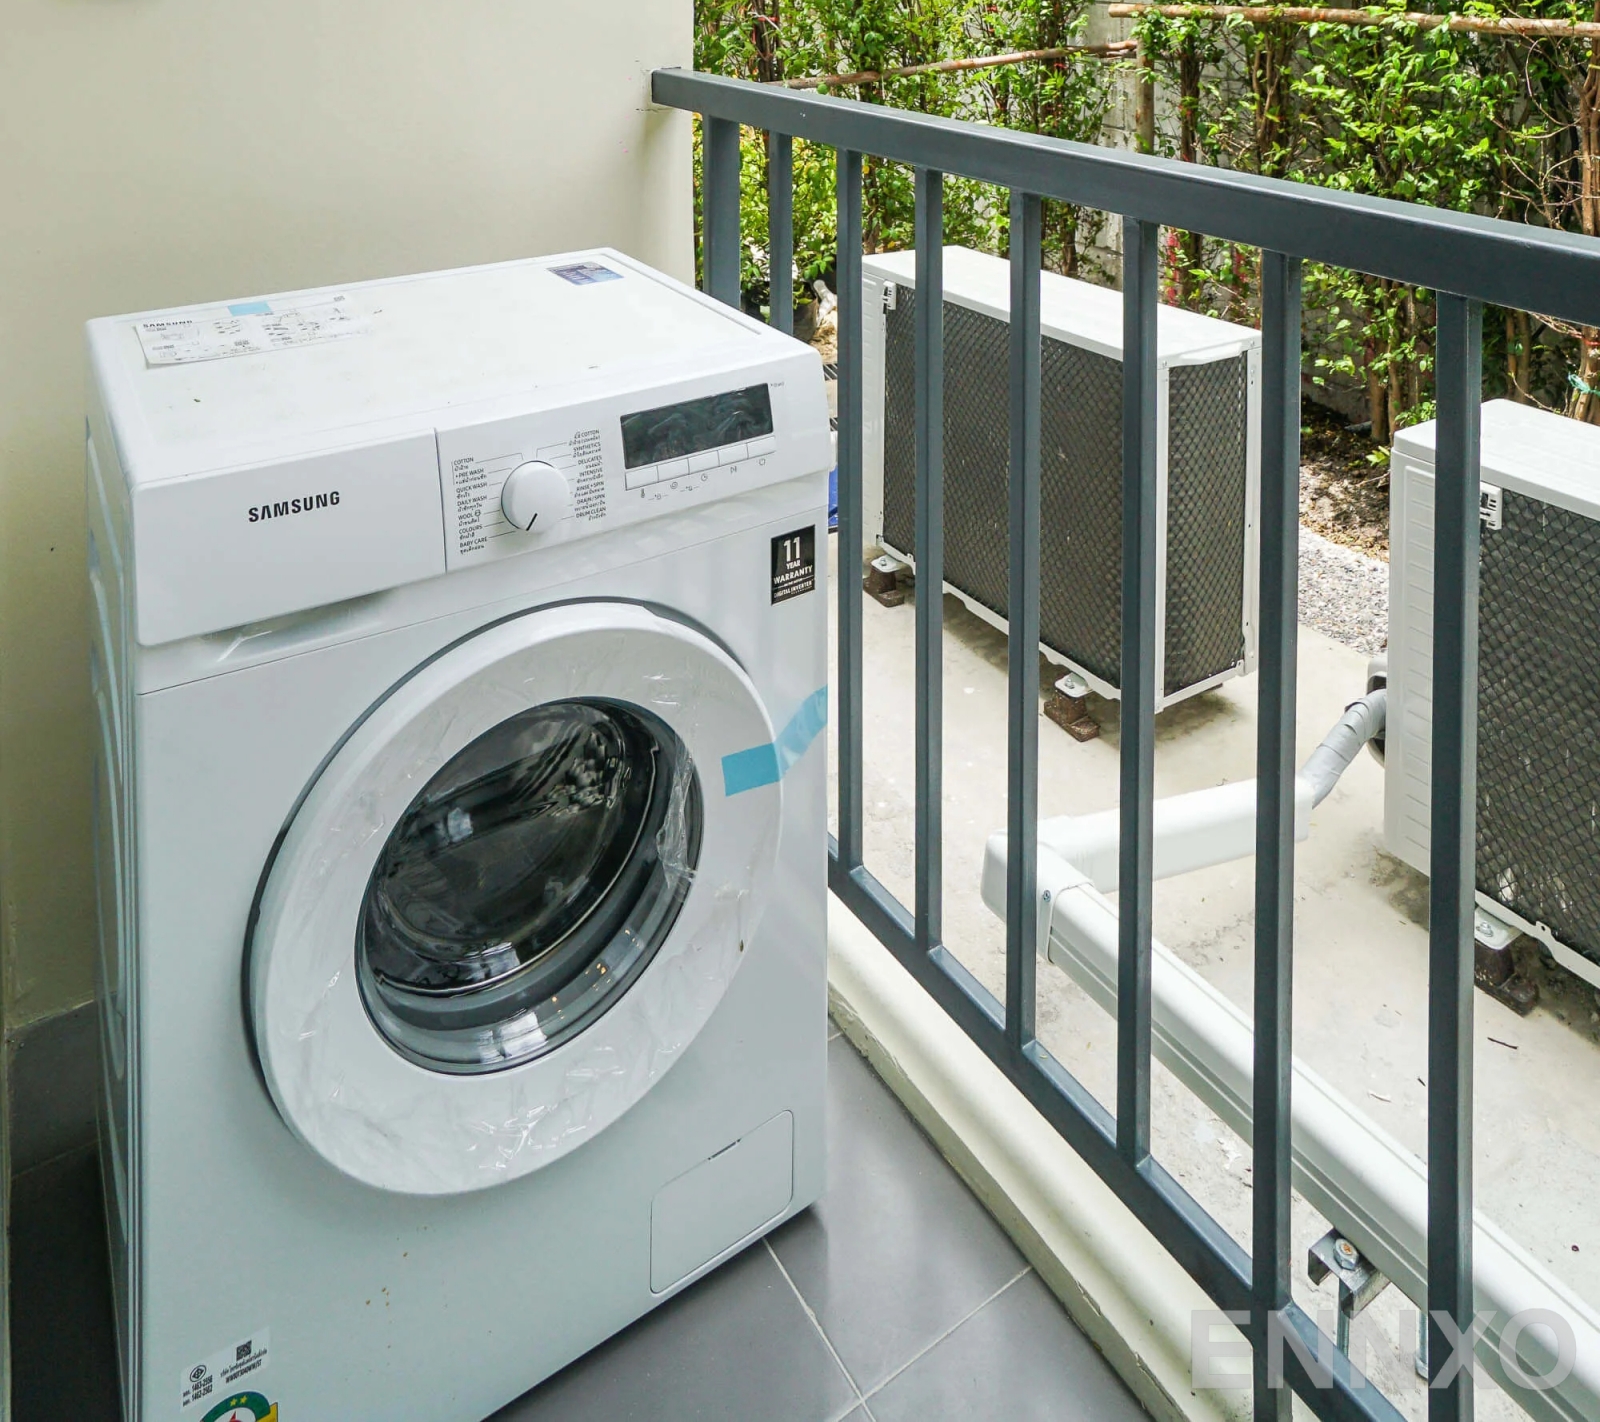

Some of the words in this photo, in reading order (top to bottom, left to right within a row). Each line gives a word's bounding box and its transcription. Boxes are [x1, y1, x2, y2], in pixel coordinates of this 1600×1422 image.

[581, 429, 599, 437] COTTON
[573, 442, 601, 452] SYNTHETICS
[454, 457, 474, 466] COTTON
[578, 455, 602, 465] DELICATES
[469, 468, 484, 476] WASH
[579, 468, 603, 477] INTENSIVE
[456, 485, 472, 494] QUICK
[472, 482, 487, 490] WASH
[248, 490, 340, 523] SAMSUNG
[457, 498, 472, 507] DAILY
[472, 495, 487, 503] WASH
[576, 510, 590, 518] DRUM
[590, 506, 606, 515] CLEAN
[459, 524, 482, 534] COLOURS
[460, 540, 473, 548] BABY
[474, 536, 487, 545] CARE
[783, 536, 801, 562] 11
[786, 559, 801, 570] YEAR
[773, 565, 813, 585] WARRANTY
